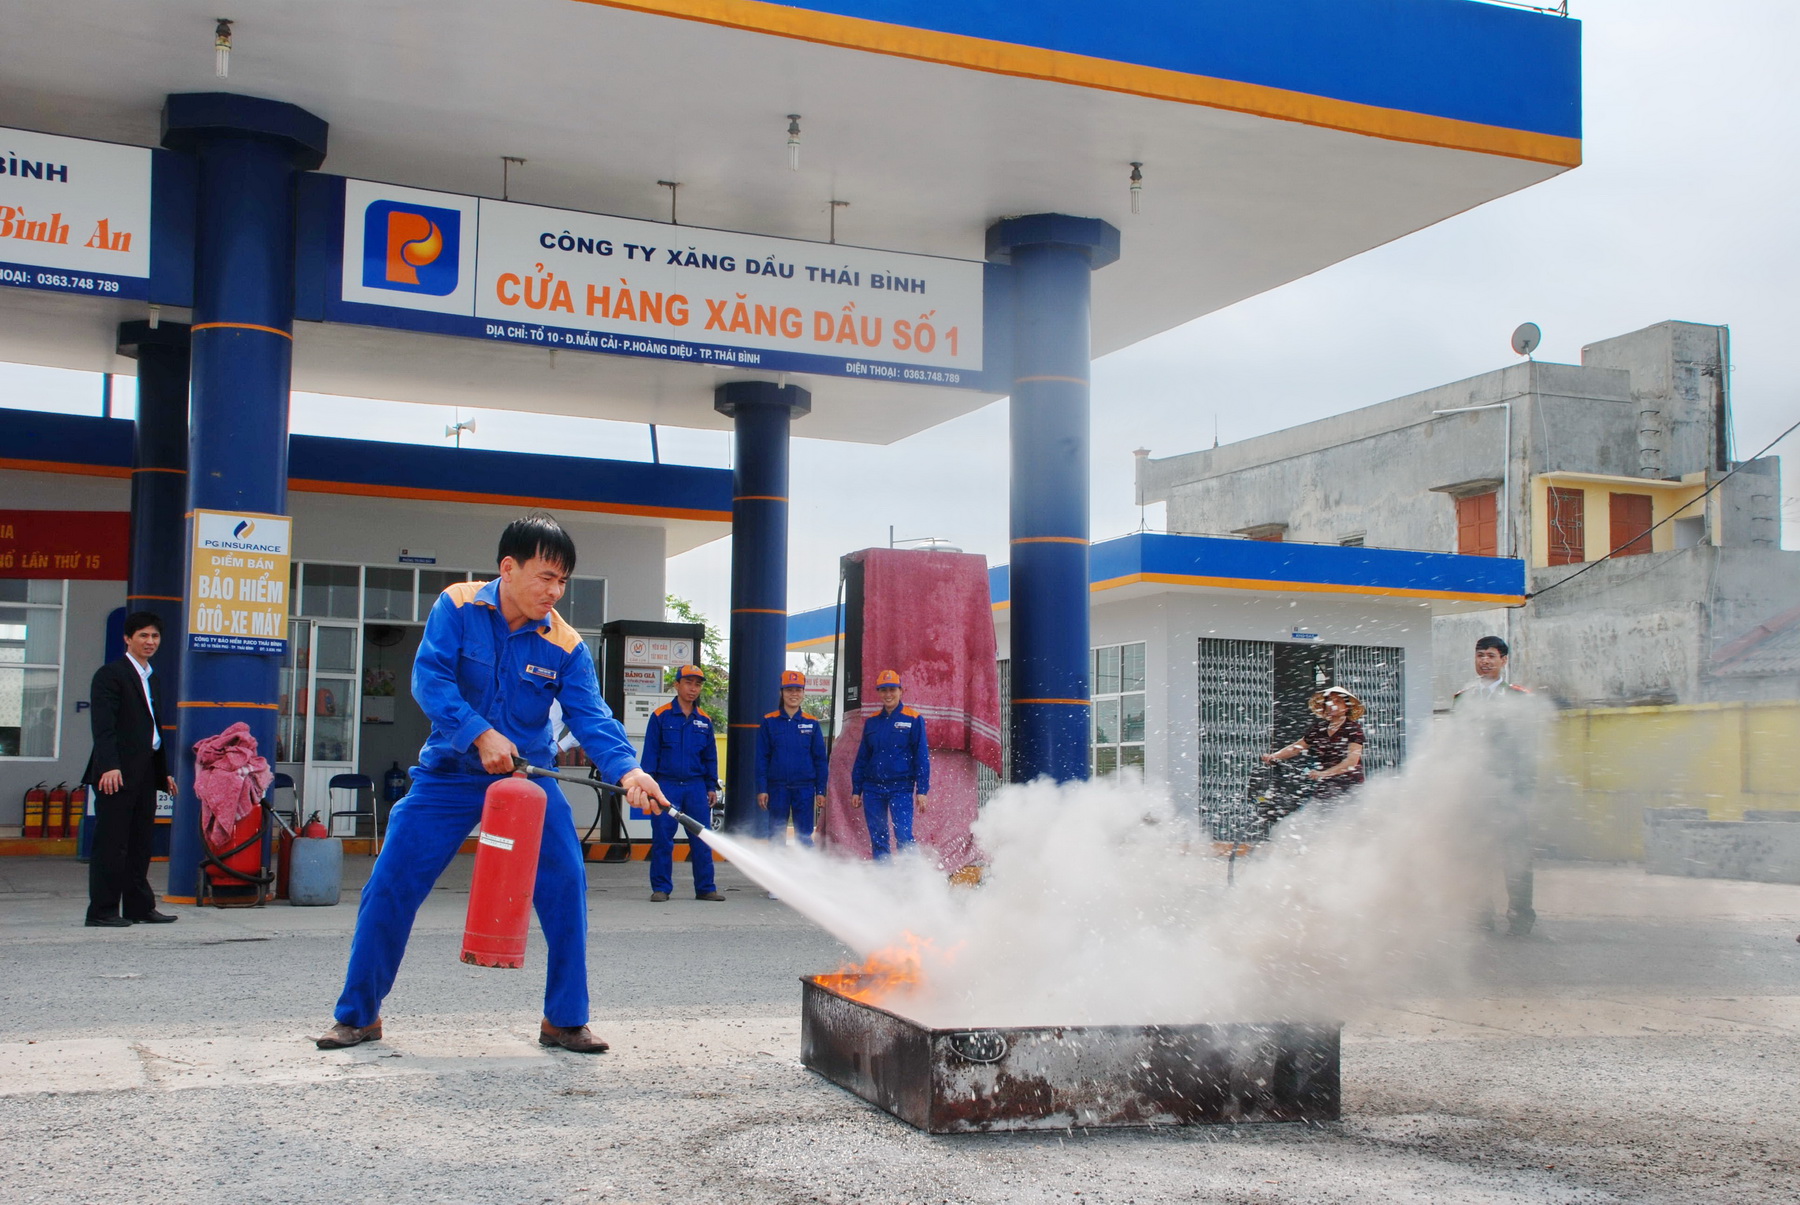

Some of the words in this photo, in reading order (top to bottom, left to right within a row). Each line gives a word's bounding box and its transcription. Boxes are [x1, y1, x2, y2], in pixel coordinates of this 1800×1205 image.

[83, 217, 132, 253] An
[540, 230, 613, 256] CÔNG
[623, 243, 657, 262] TY
[667, 246, 736, 272] XĂNG
[745, 254, 794, 279] DẦU
[805, 265, 860, 287] THÁI
[870, 270, 926, 295] BÌNH
[37, 273, 94, 290] 0363.748
[97, 280, 119, 293] 789
[496, 262, 575, 314] CỬA
[586, 277, 689, 327] HÀNG
[704, 292, 803, 339] XĂNG
[814, 301, 882, 348] DẦU
[892, 310, 936, 354] SỐ
[945, 325, 958, 357] 1
[486, 324, 505, 338] ĐỊA
[507, 324, 528, 339] CHỈ:
[530, 325, 544, 341] TỔ
[547, 332, 559, 343] 10
[600, 335, 618, 349] CẢI
[670, 344, 693, 359] DIỆU
[714, 348, 736, 362] THÁI
[738, 350, 760, 364] BÌNH
[846, 362, 868, 375] ĐIỆN
[903, 369, 960, 383] 0363.748.789
[22, 550, 48, 568] LẦN
[54, 550, 81, 568] THỨ
[86, 554, 100, 569] 15
[204, 539, 219, 547] PG
[221, 541, 281, 553] INSURANCE
[211, 552, 244, 567] ĐIỂM
[247, 557, 274, 570] BÁN
[198, 568, 234, 600] BẢO
[239, 572, 283, 604] HIỂM
[251, 608, 281, 636] MÁY
